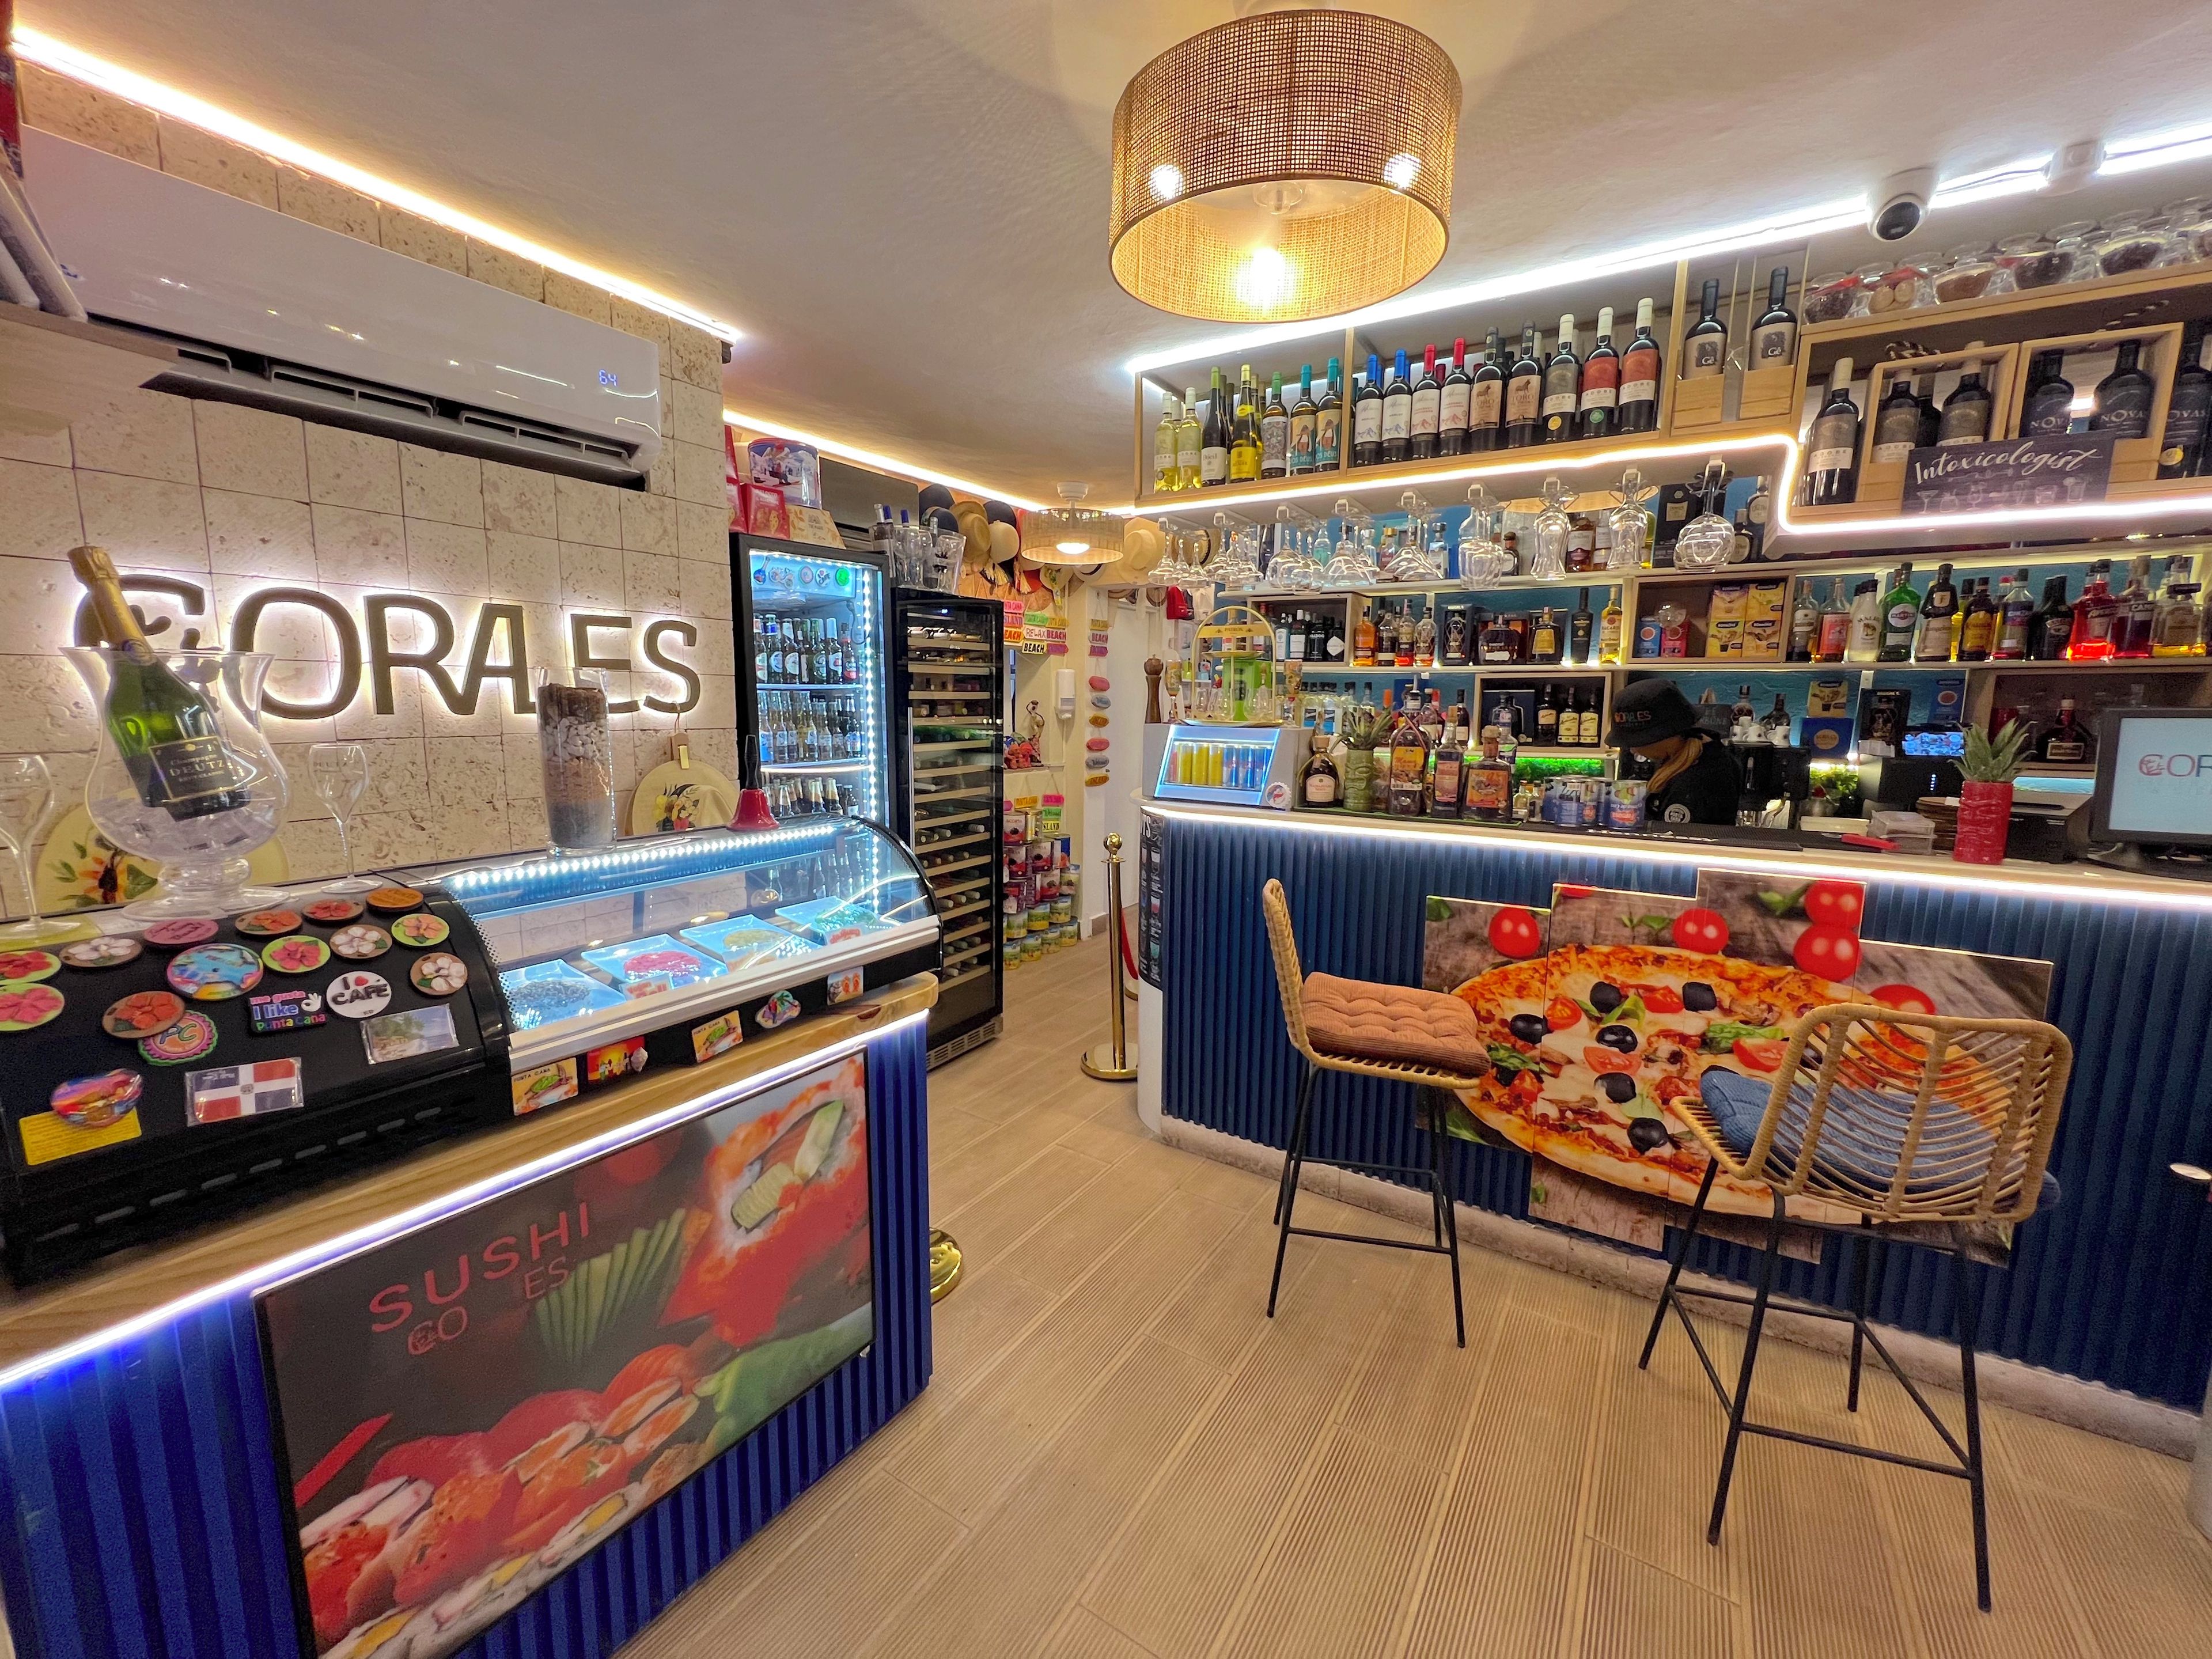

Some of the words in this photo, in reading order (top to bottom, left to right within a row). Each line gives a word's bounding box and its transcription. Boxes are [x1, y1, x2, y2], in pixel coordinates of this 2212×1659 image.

[599, 369, 616, 387] 64
[2101, 409, 2145, 422] NOVA
[2167, 409, 2206, 422] OVAS
[1914, 440, 2106, 485] Intoxicologist
[1026, 628, 1047, 637] RELAX
[1047, 630, 1066, 639] BEACH
[1024, 643, 1044, 653] BEACH
[170, 760, 225, 777] DEUTZ
[342, 976, 351, 990] I
[272, 990, 306, 1003] gusta
[252, 1006, 262, 1020] I
[263, 1002, 300, 1019] like
[159, 1023, 197, 1045] PC
[369, 1202, 589, 1333] SUSHI
